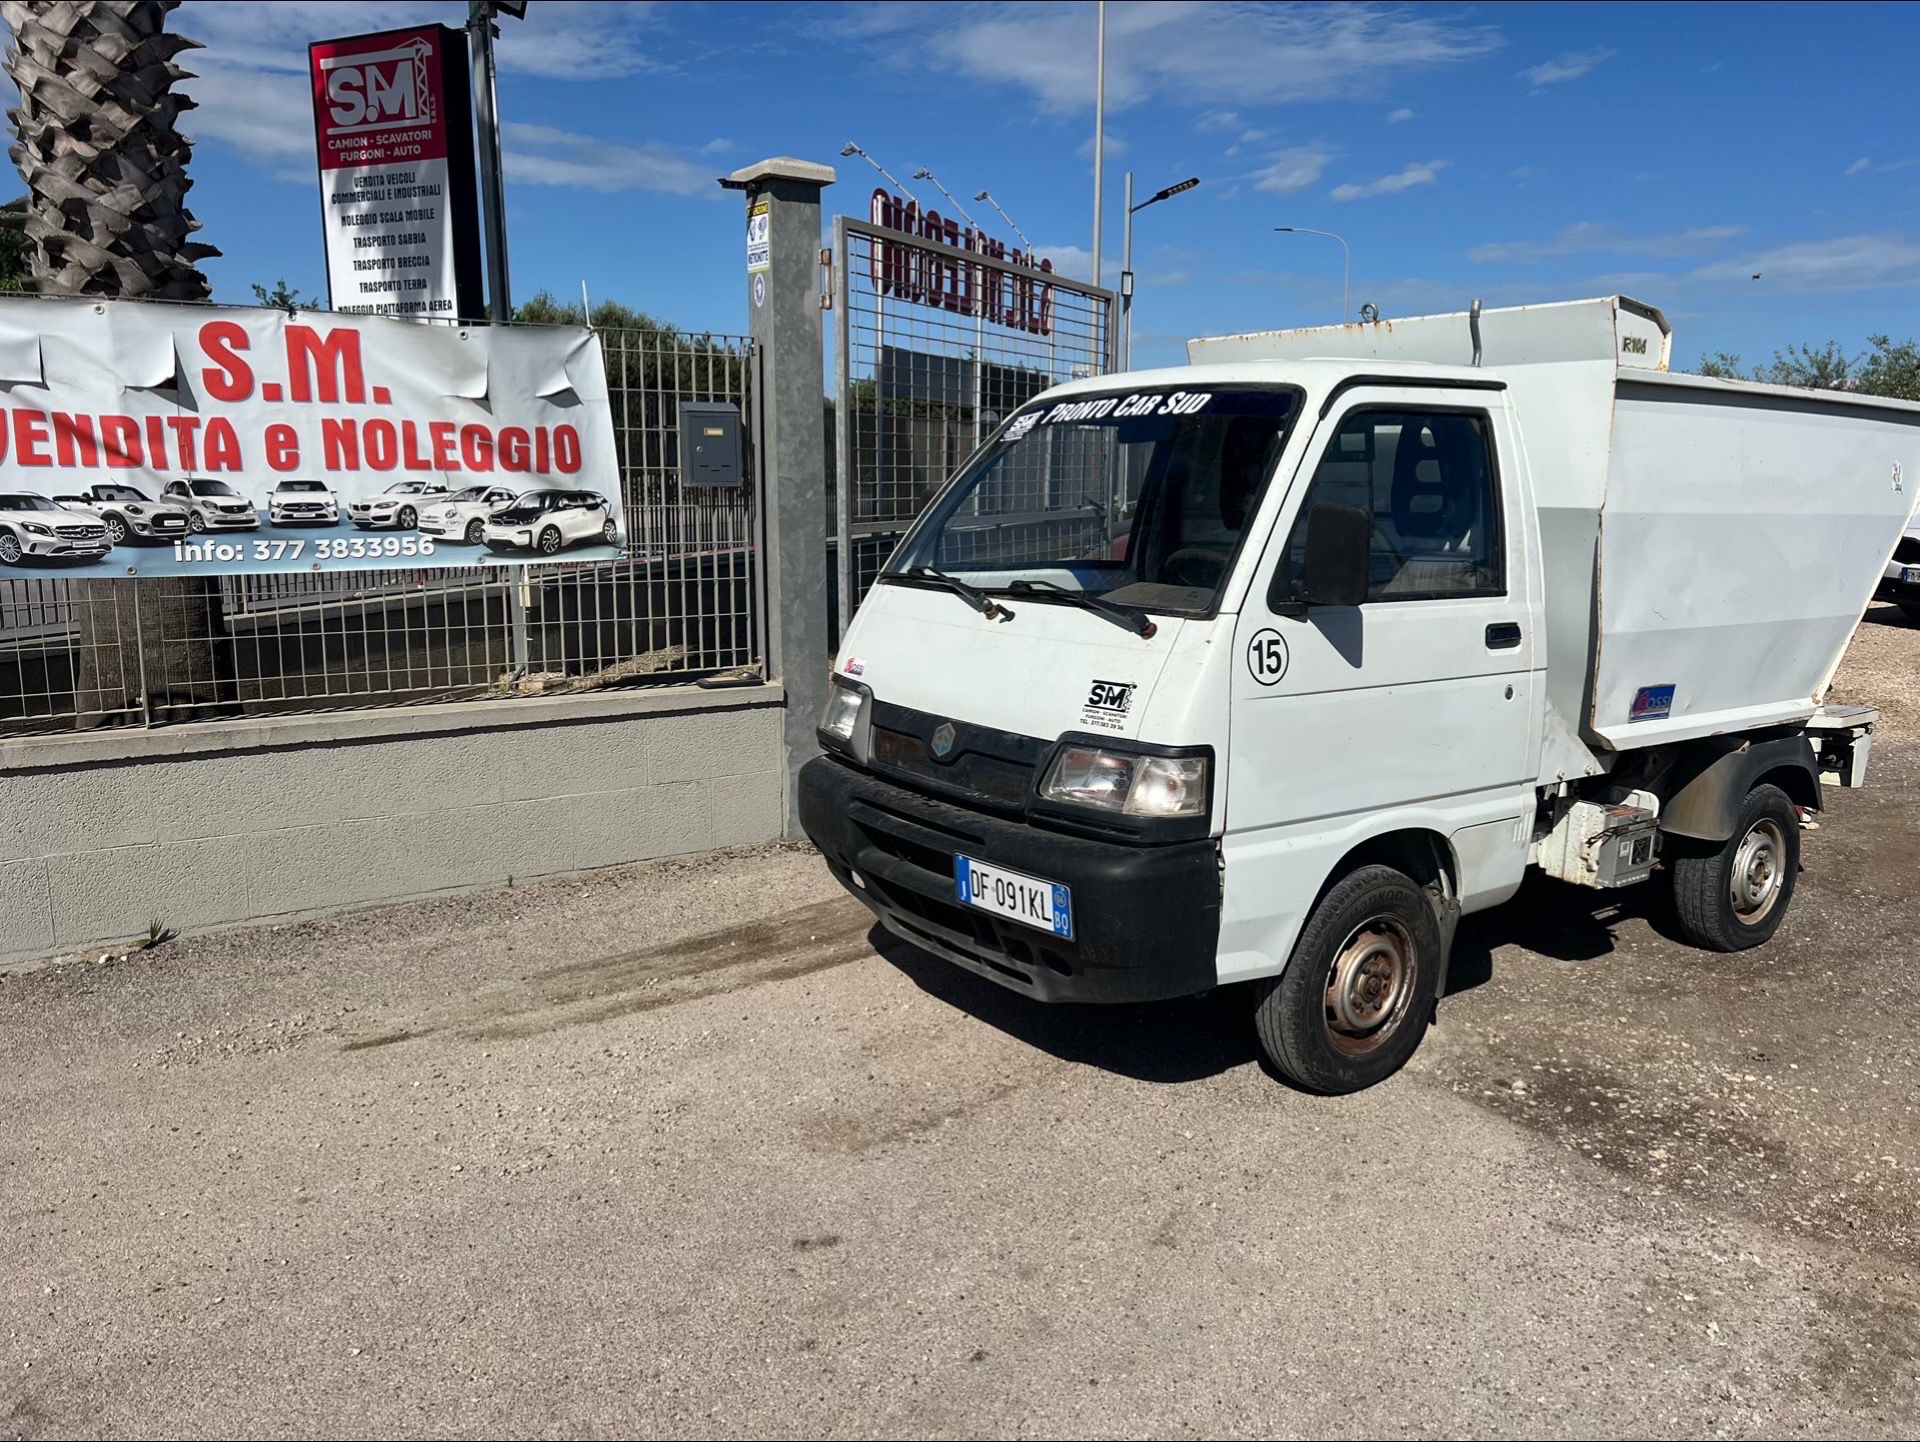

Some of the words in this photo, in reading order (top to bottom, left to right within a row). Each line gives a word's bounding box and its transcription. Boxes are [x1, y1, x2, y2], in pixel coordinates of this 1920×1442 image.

[328, 137, 368, 150] CAMION
[376, 130, 432, 145] SCAVATORI
[340, 148, 385, 161] FURGONI
[393, 145, 421, 157] AUTO
[354, 175, 385, 188] VENDITA
[386, 172, 415, 185] VEICOLI
[332, 191, 385, 204] COMMERCIALI
[387, 190, 392, 200] E
[394, 184, 440, 198] INDUSTRIALI
[341, 213, 377, 227] NOLEGGIO
[380, 211, 403, 224] SCALA
[405, 208, 435, 221] MOBILE
[353, 235, 396, 248] TRASPORTO
[398, 232, 426, 245] SABBIA
[353, 258, 396, 271] TRASPORTO
[398, 255, 430, 268] BRECCIA
[359, 281, 402, 293] TRASPORTO
[404, 278, 427, 290] TERRA
[338, 304, 374, 315] NOLEGGIO
[376, 301, 427, 314] PIATTAFORMA
[429, 299, 452, 312] AEREA
[198, 321, 393, 405] S.M.
[1041, 398, 1118, 424] PRONTO
[1113, 393, 1164, 417] CAR
[1158, 391, 1213, 415] SUD
[0, 408, 242, 473] ENDITA
[265, 424, 300, 472] e
[322, 417, 584, 474] NOLEGGIO
[174, 539, 244, 562] info:
[253, 539, 306, 561] 377
[314, 536, 435, 559] 3833956
[1252, 639, 1282, 675] 15
[971, 869, 990, 900] DF
[995, 877, 1052, 923] 091KL
